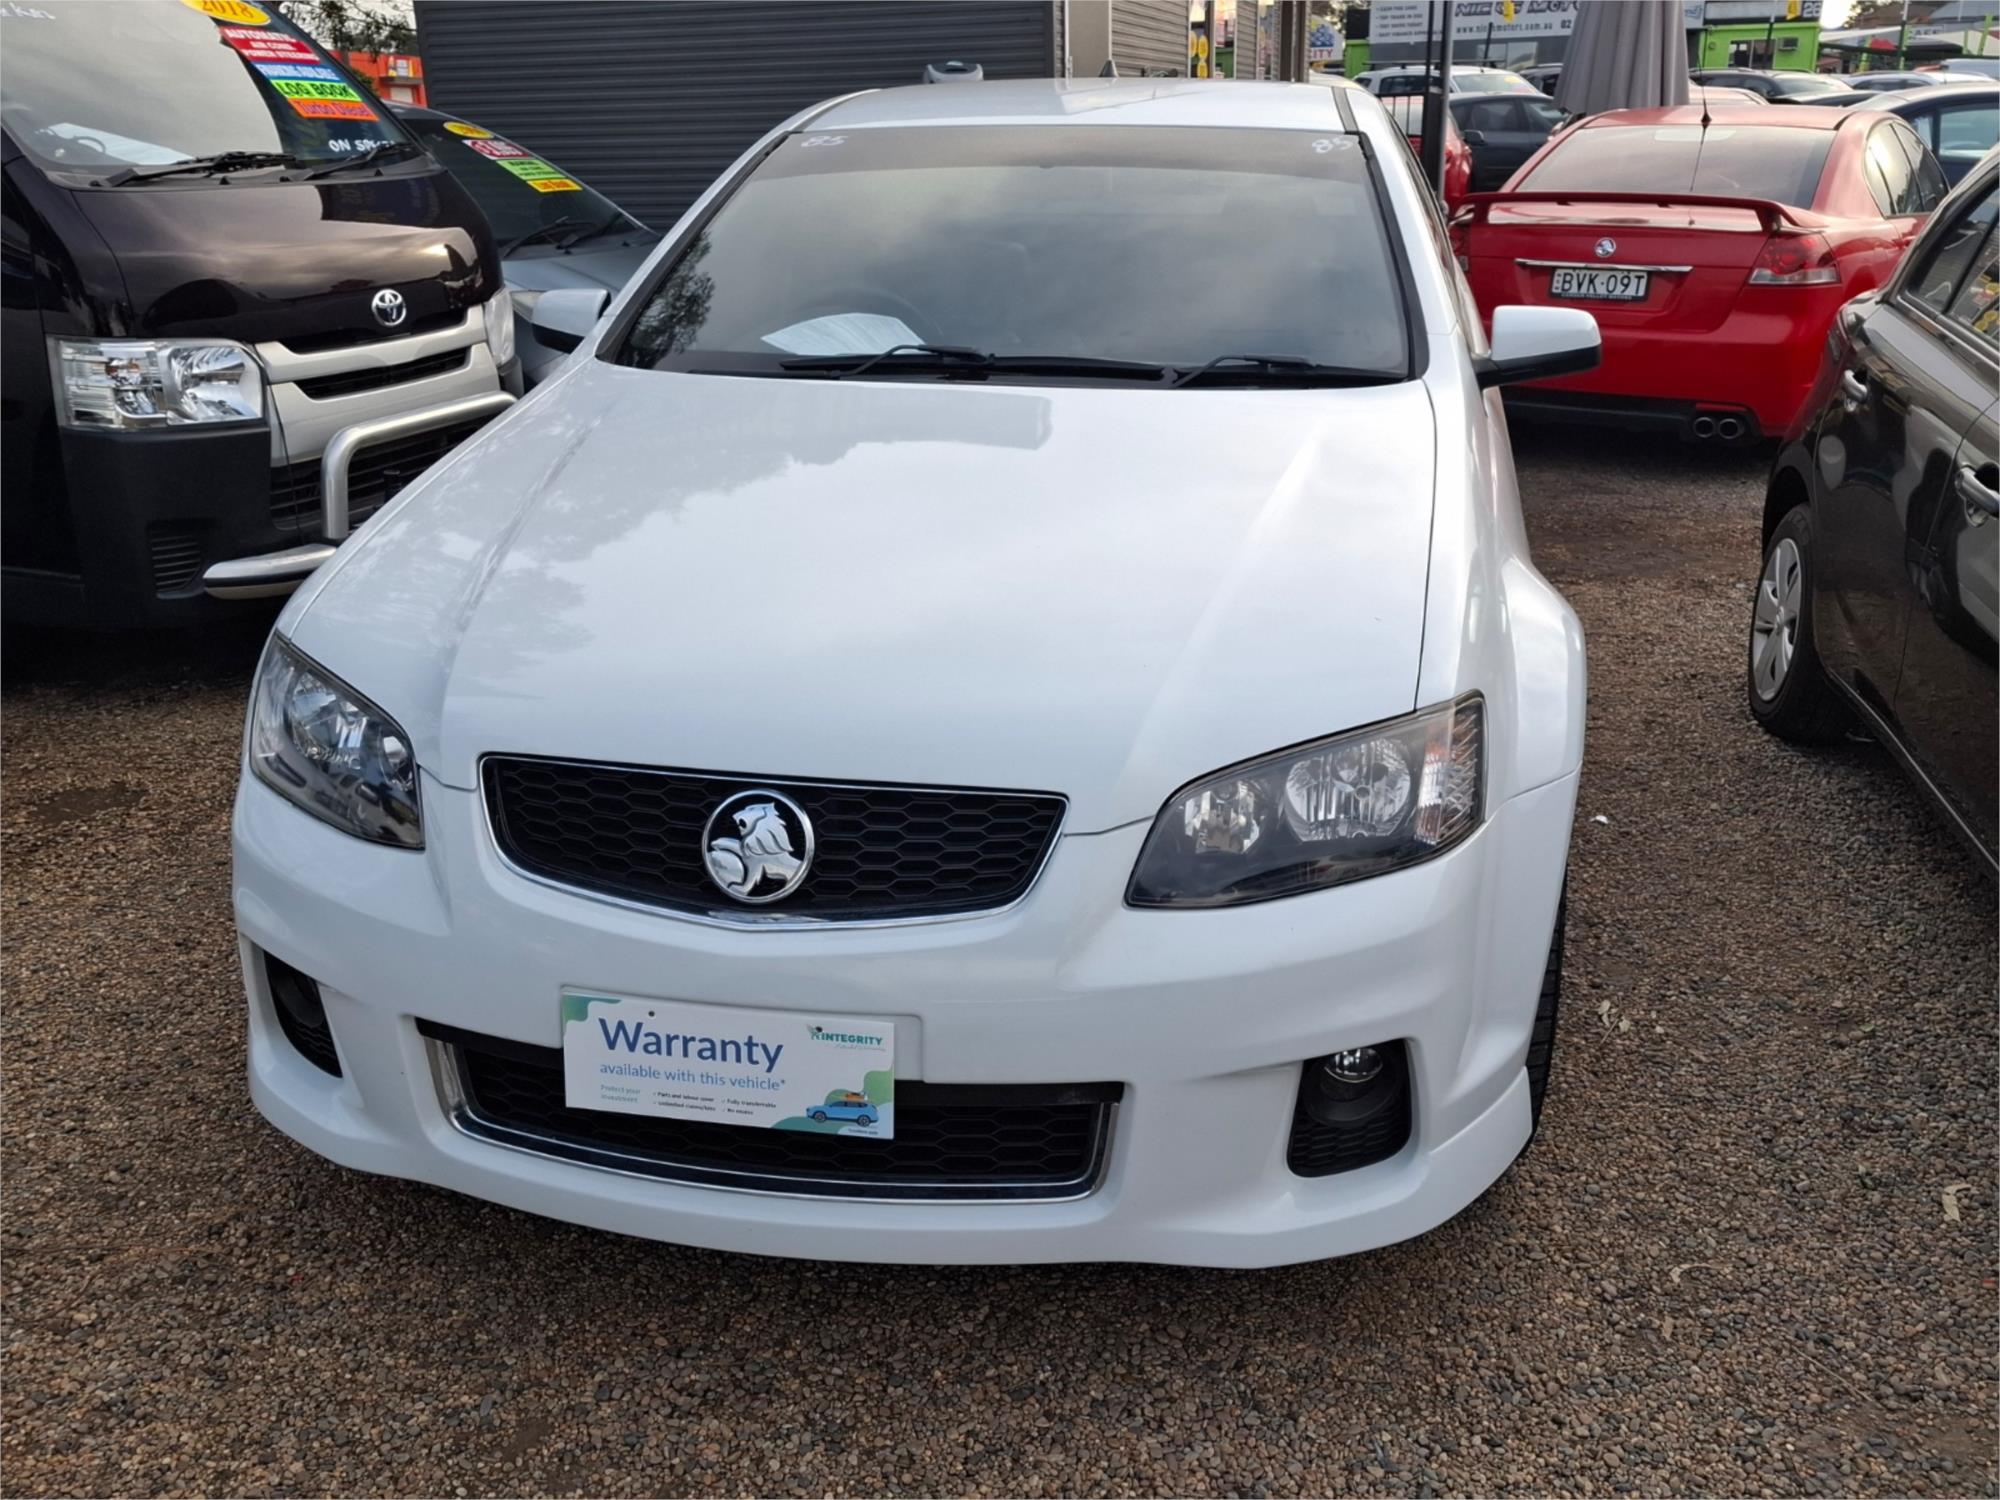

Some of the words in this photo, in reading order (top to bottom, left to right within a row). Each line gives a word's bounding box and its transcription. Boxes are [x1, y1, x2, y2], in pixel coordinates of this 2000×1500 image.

[203, 0, 254, 18] 2018
[275, 82, 311, 97] LOG
[309, 83, 351, 98] BOOK
[328, 139, 351, 152] ON
[599, 1018, 784, 1074] Warranty
[822, 1032, 882, 1046] INTEGRITY
[600, 1063, 661, 1080] available
[664, 1070, 696, 1084] with
[700, 1073, 726, 1087] this
